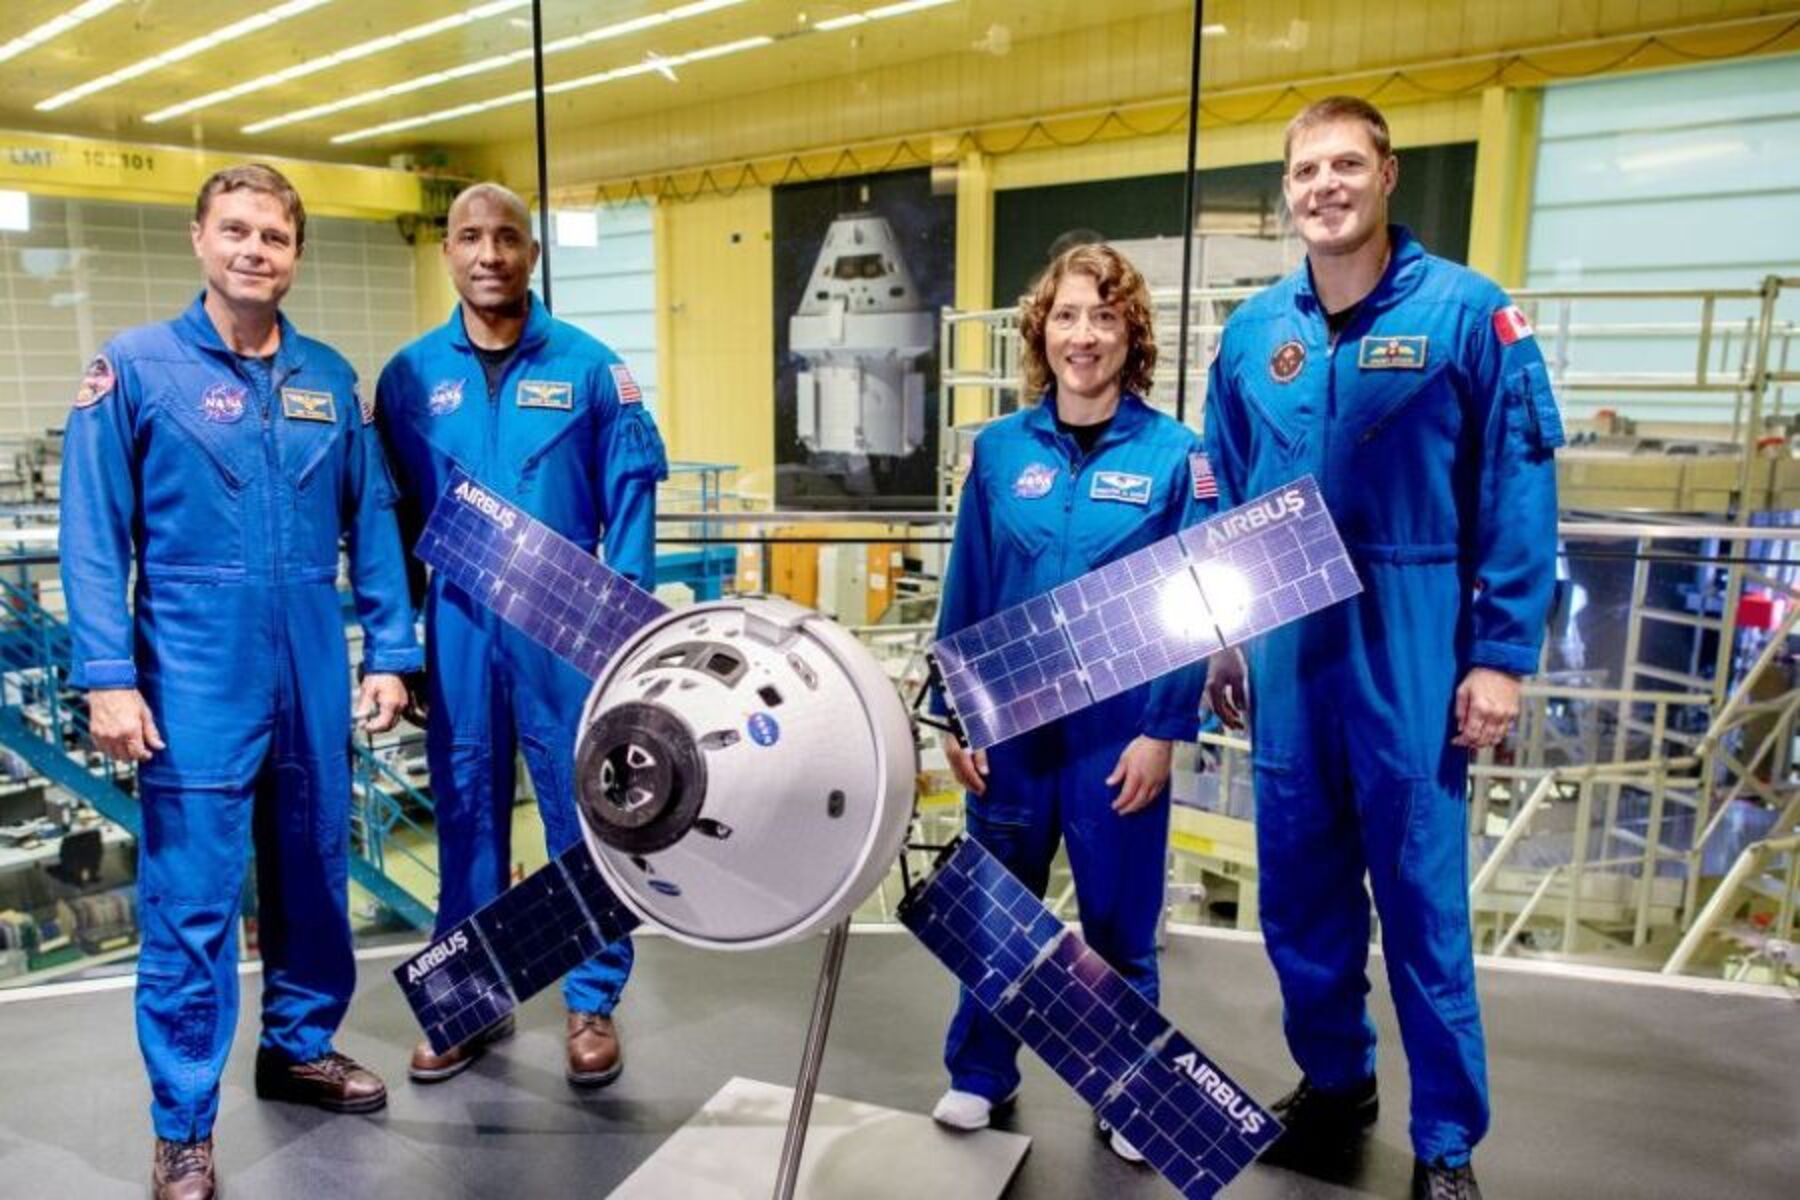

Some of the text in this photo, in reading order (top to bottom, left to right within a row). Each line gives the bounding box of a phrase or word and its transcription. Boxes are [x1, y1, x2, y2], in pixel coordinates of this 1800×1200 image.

[454, 481, 517, 530] AIRBUS
[1206, 488, 1305, 546] AIRBUS
[407, 930, 469, 984] AIRBUS
[1173, 1051, 1266, 1135] AIRBUS
